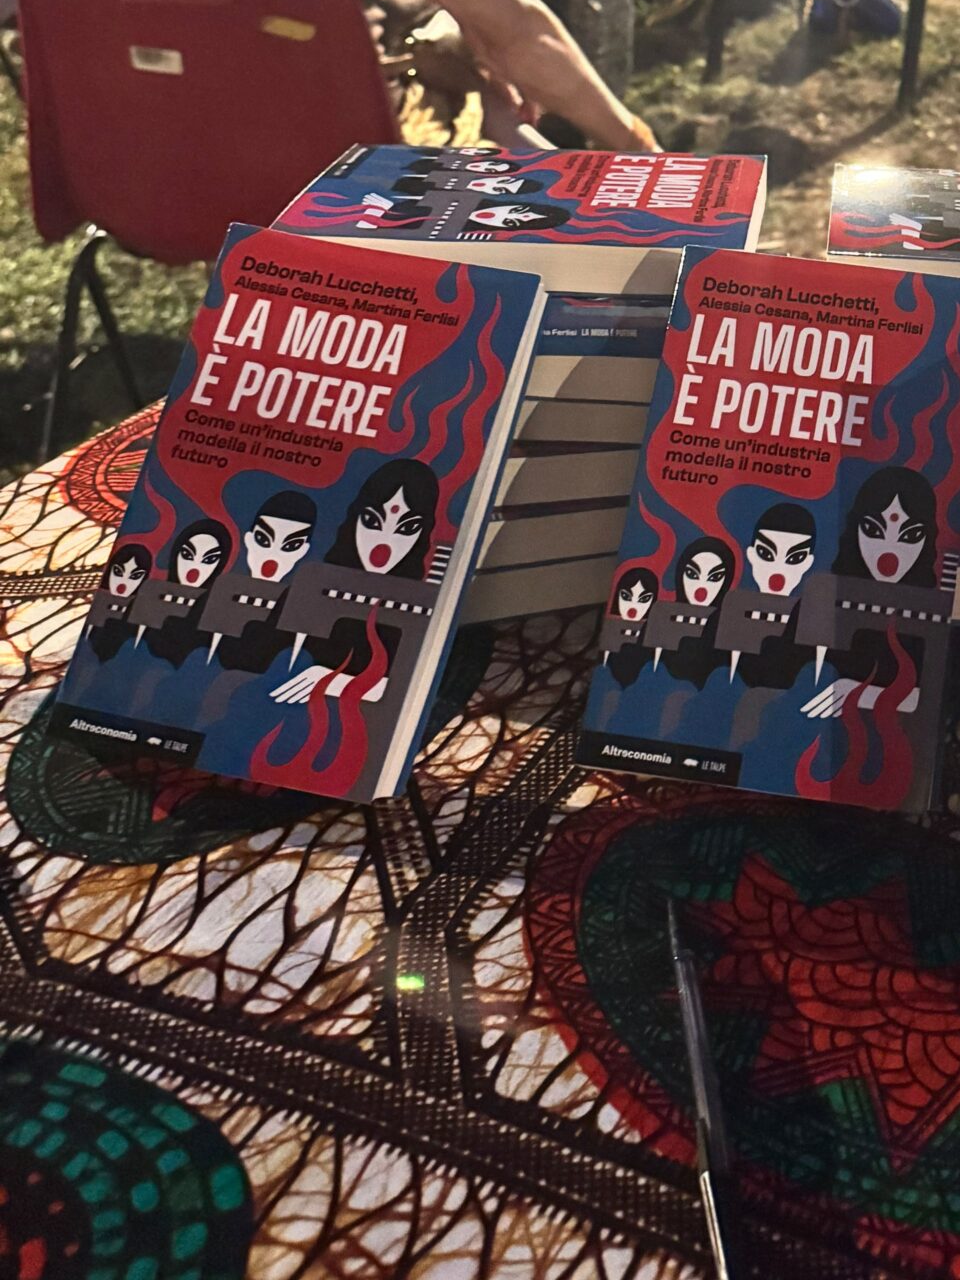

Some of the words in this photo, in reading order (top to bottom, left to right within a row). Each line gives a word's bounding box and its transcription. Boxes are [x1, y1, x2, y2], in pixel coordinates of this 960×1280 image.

[663, 158, 709, 171] LA
[590, 165, 654, 208] POTERE
[646, 173, 703, 208] MODA
[240, 256, 323, 285] Deborah
[326, 273, 418, 305] Lucchetti,
[702, 276, 783, 301] Deborah
[786, 287, 880, 315] Lucchetti,
[234, 276, 288, 297] Alessia
[291, 286, 349, 310] Cesana,
[352, 298, 410, 320] Martina
[413, 308, 461, 327] Ferlisi
[698, 296, 751, 314] Alessia
[754, 303, 813, 324] Cesana,
[816, 310, 875, 329] Martina
[877, 318, 924, 336] Ferlisi
[213, 293, 272, 350] LA
[277, 306, 408, 375] MODA
[686, 313, 737, 367] LA
[750, 321, 874, 385] MODA
[190, 343, 228, 406] È
[227, 360, 392, 438] POTERE
[673, 363, 704, 426] È
[710, 378, 869, 447] POTERE
[177, 427, 247, 453] modella
[250, 441, 261, 457] il
[262, 446, 322, 467] nostro
[184, 409, 236, 432] Come
[239, 421, 343, 452] un'industria
[669, 429, 721, 449] Come
[725, 437, 831, 463] un'industria
[170, 446, 228, 469] futuro
[661, 465, 719, 486] futuro
[665, 448, 735, 470] modella
[738, 456, 749, 471] il
[751, 460, 812, 479] nostro
[69, 718, 138, 742] Altreconomia
[601, 744, 673, 765] Altreconomia
